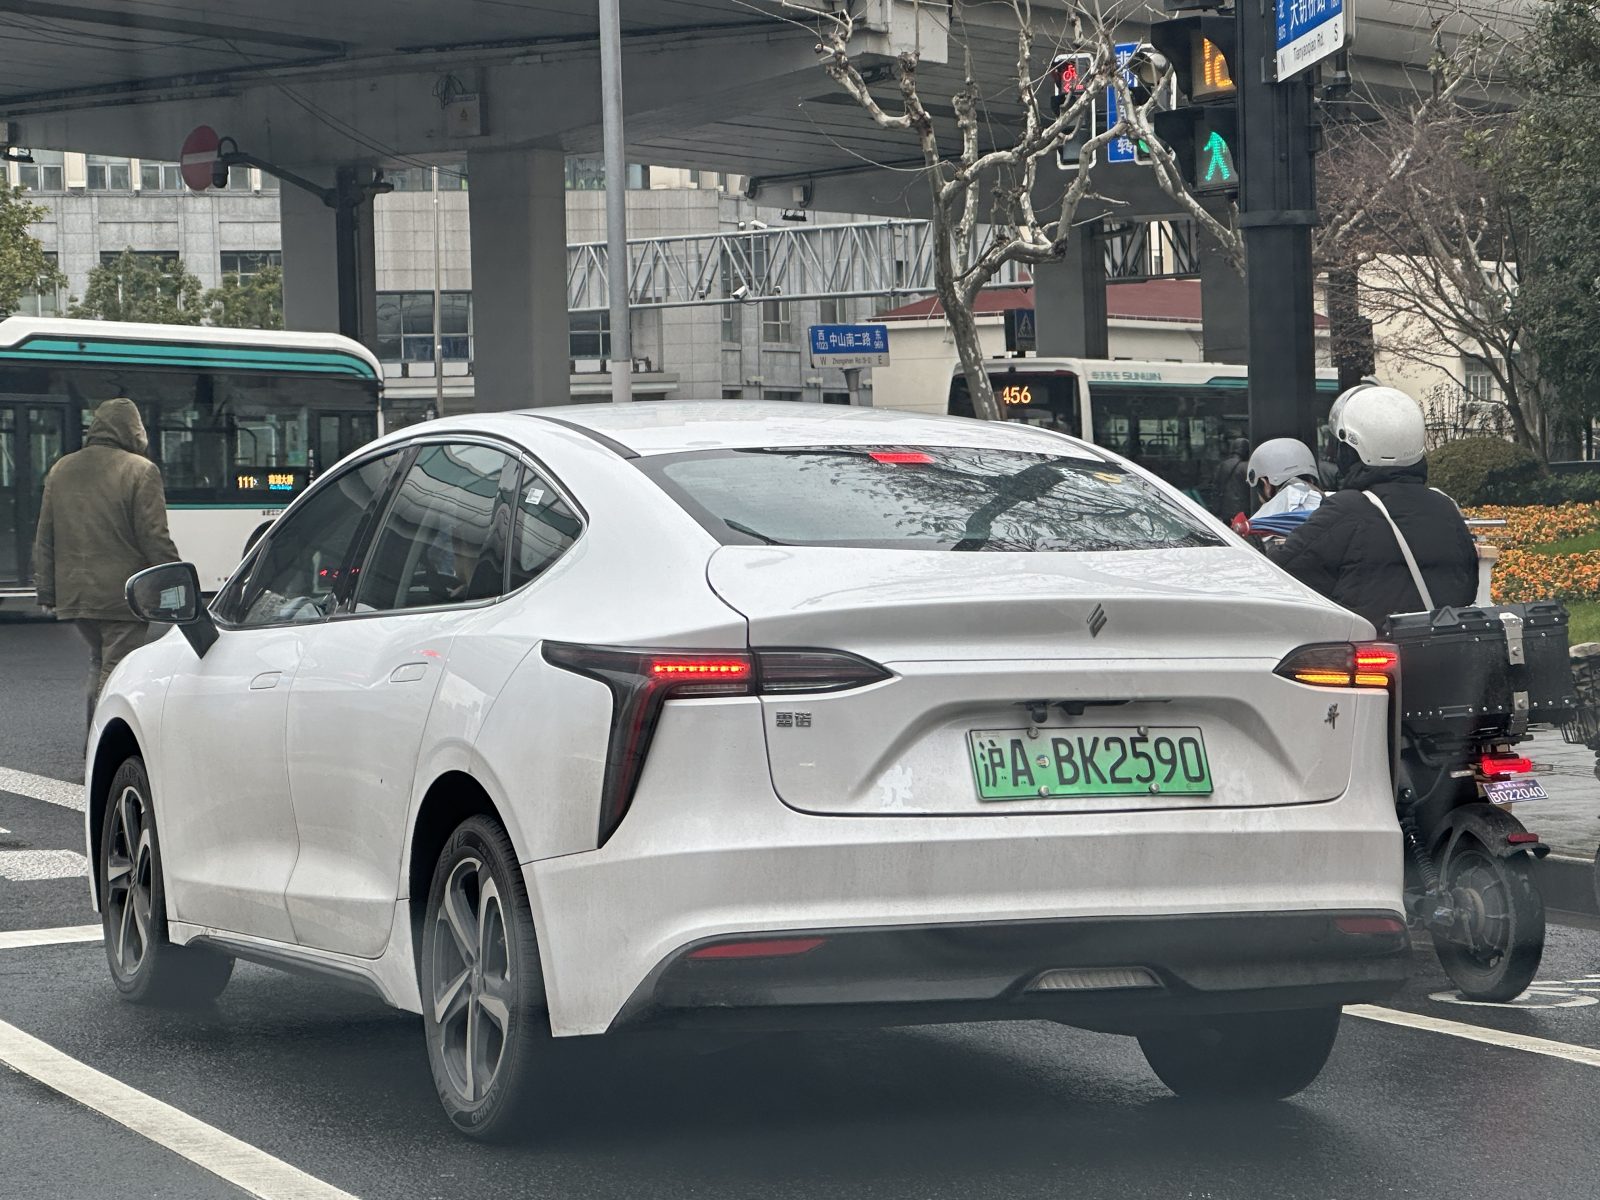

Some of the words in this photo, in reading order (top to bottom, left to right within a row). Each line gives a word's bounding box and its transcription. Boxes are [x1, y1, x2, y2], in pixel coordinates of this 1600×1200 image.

[1334, 23, 1339, 42] S
[1280, 53, 1286, 73] N
[817, 329, 825, 341] 西
[829, 332, 870, 347] 中山南二路
[875, 329, 881, 340] 东
[820, 356, 827, 366] W
[878, 355, 882, 365] E
[1122, 372, 1162, 381] SUNWIN
[1002, 386, 1032, 404] 456
[237, 476, 254, 488] 111
[979, 738, 1036, 787] 沪A
[1051, 735, 1206, 786] BK2590
